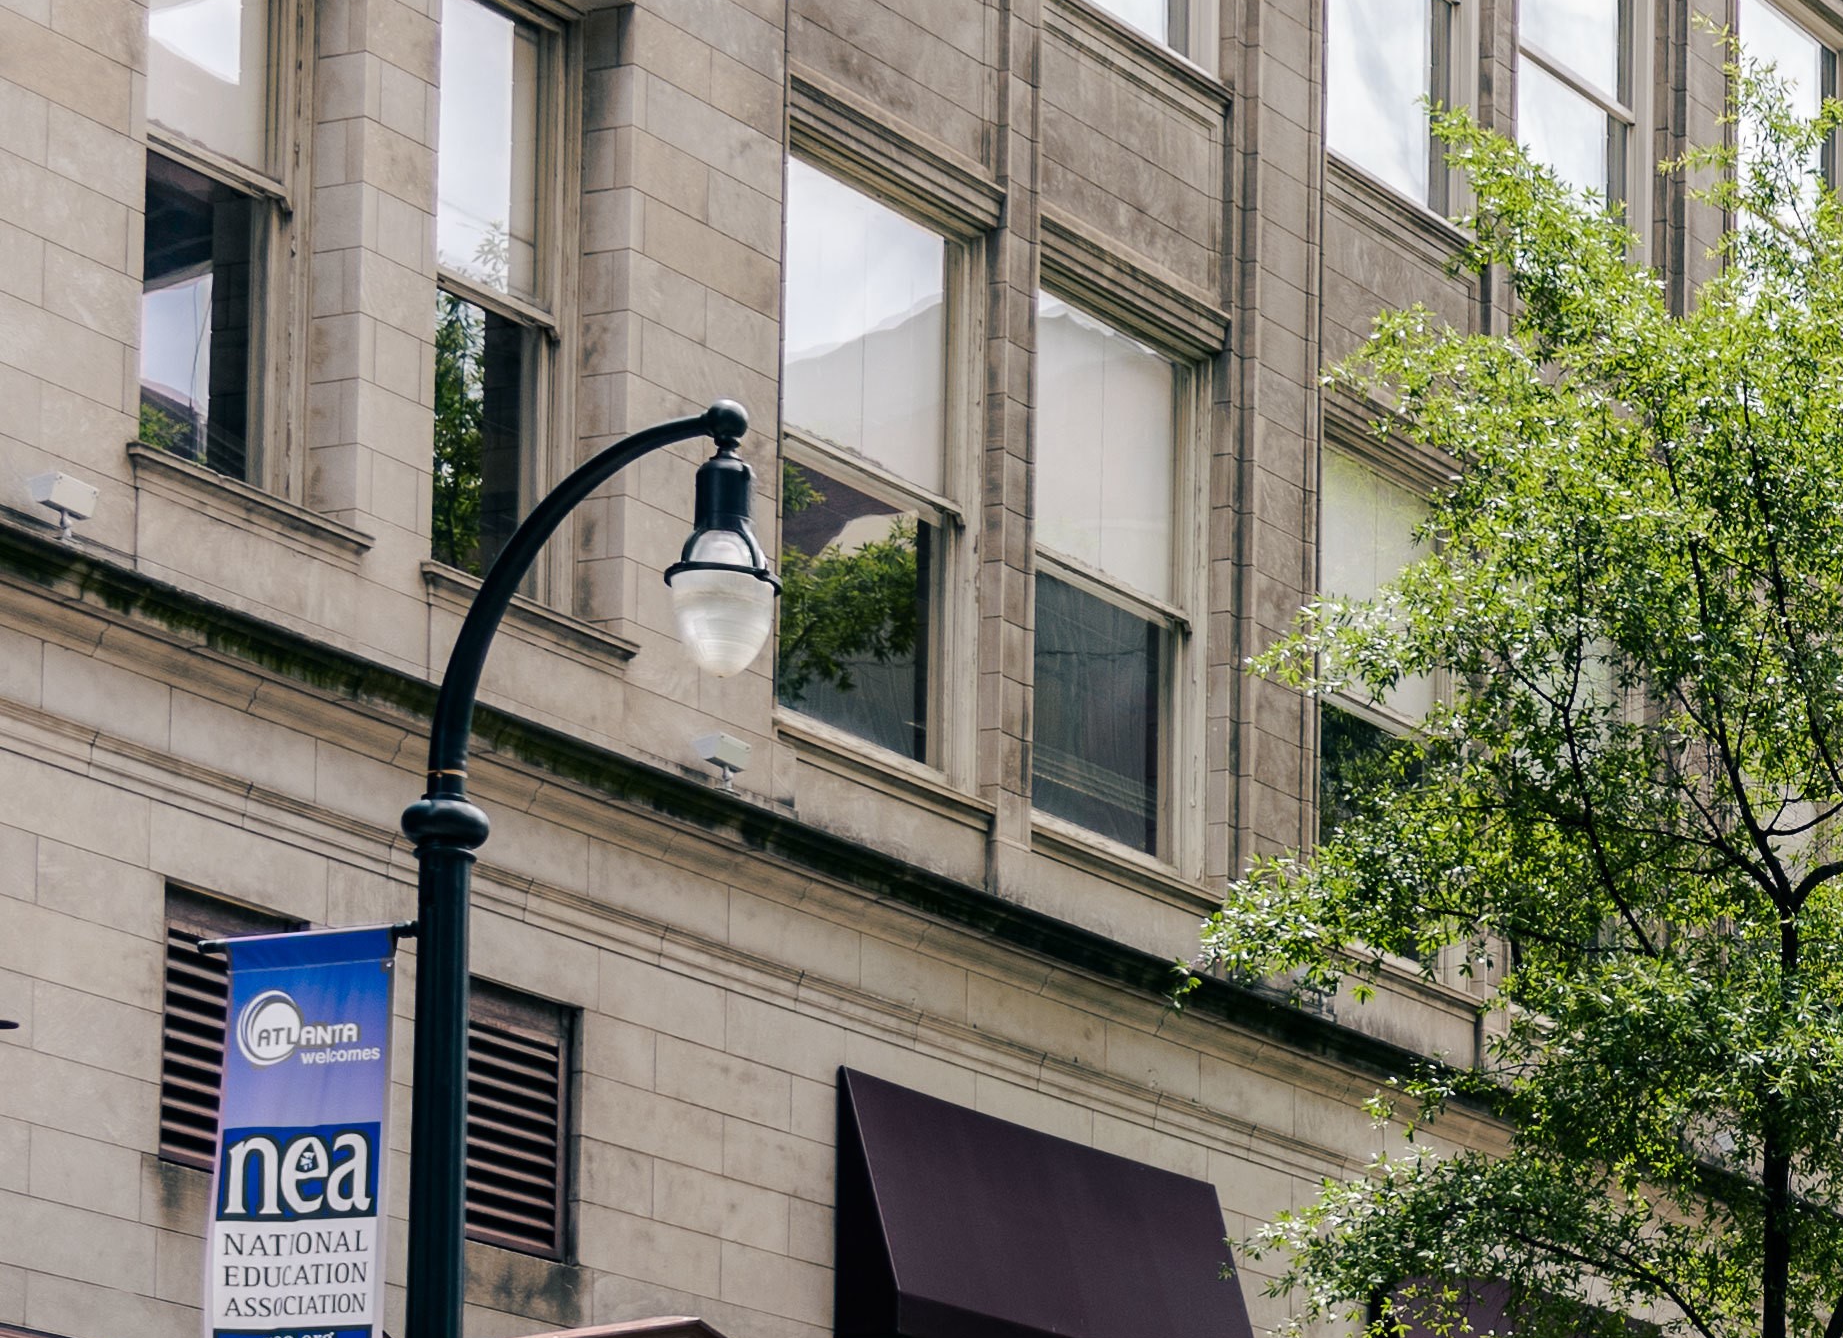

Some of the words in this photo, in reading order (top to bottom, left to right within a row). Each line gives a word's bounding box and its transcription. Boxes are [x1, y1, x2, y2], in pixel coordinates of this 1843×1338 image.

[257, 1022, 358, 1048] ATLANTA
[301, 1046, 381, 1064] welcomes
[224, 1133, 372, 1214] nea
[223, 1229, 368, 1256] NATIONAL
[224, 1261, 367, 1288] EDUCATION
[223, 1292, 366, 1317] ASSOCIATION
